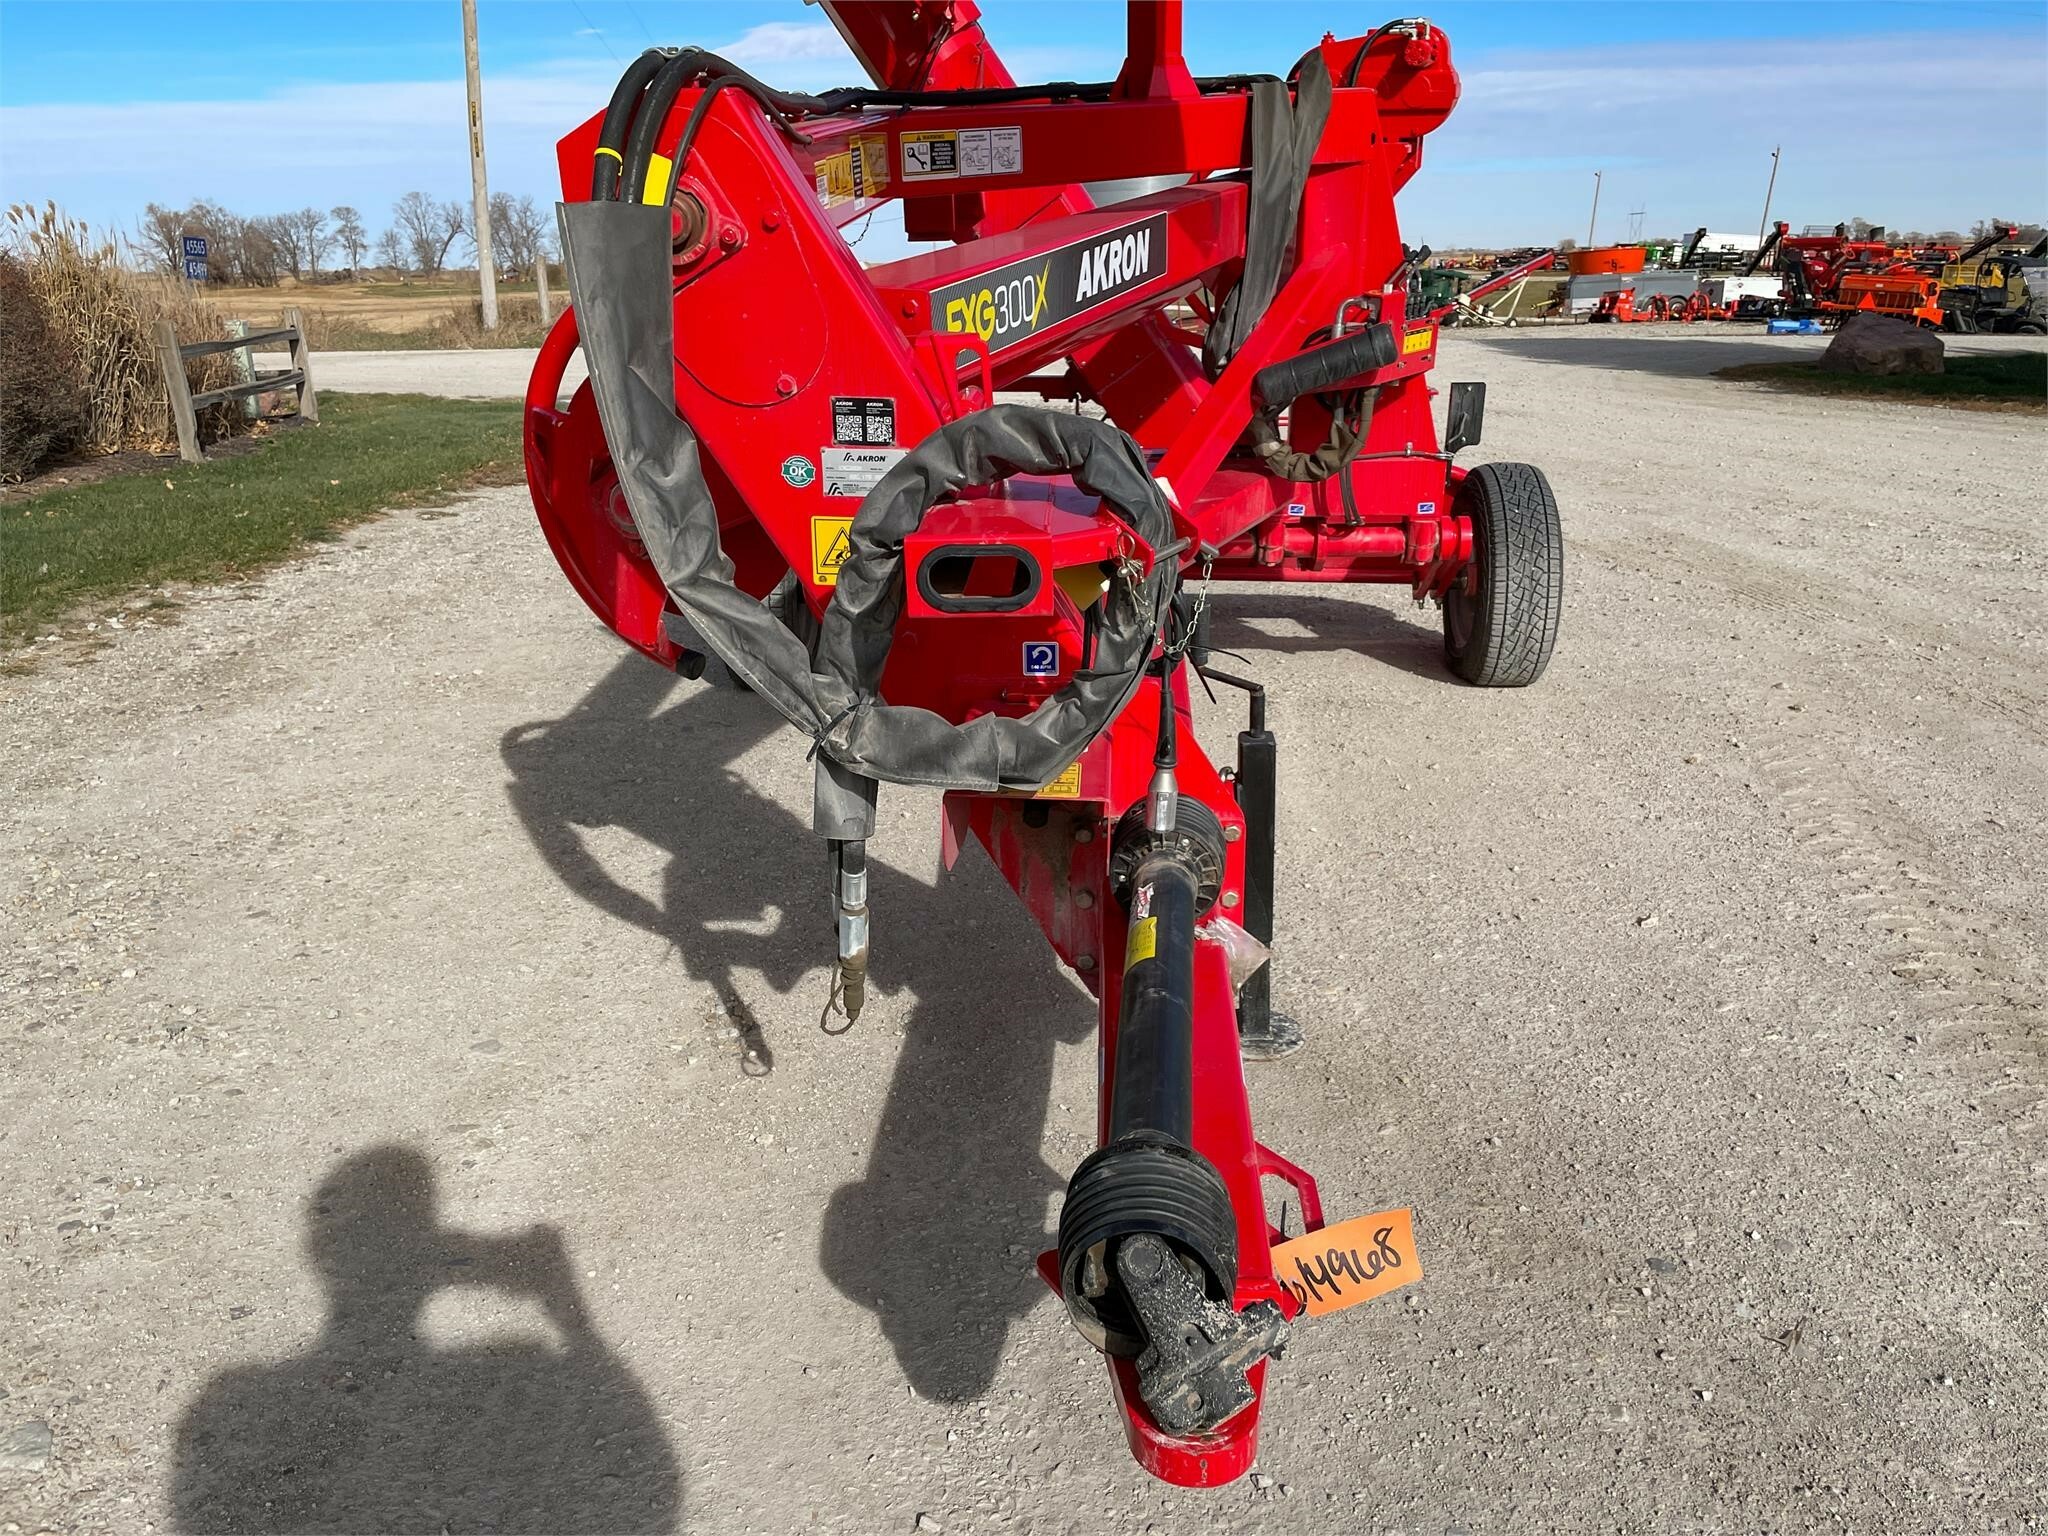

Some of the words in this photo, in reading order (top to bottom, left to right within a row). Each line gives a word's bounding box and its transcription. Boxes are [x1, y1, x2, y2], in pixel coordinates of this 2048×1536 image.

[186, 240, 205, 254] 45565
[1076, 228, 1150, 303] AKRON
[789, 466, 807, 477] OK
